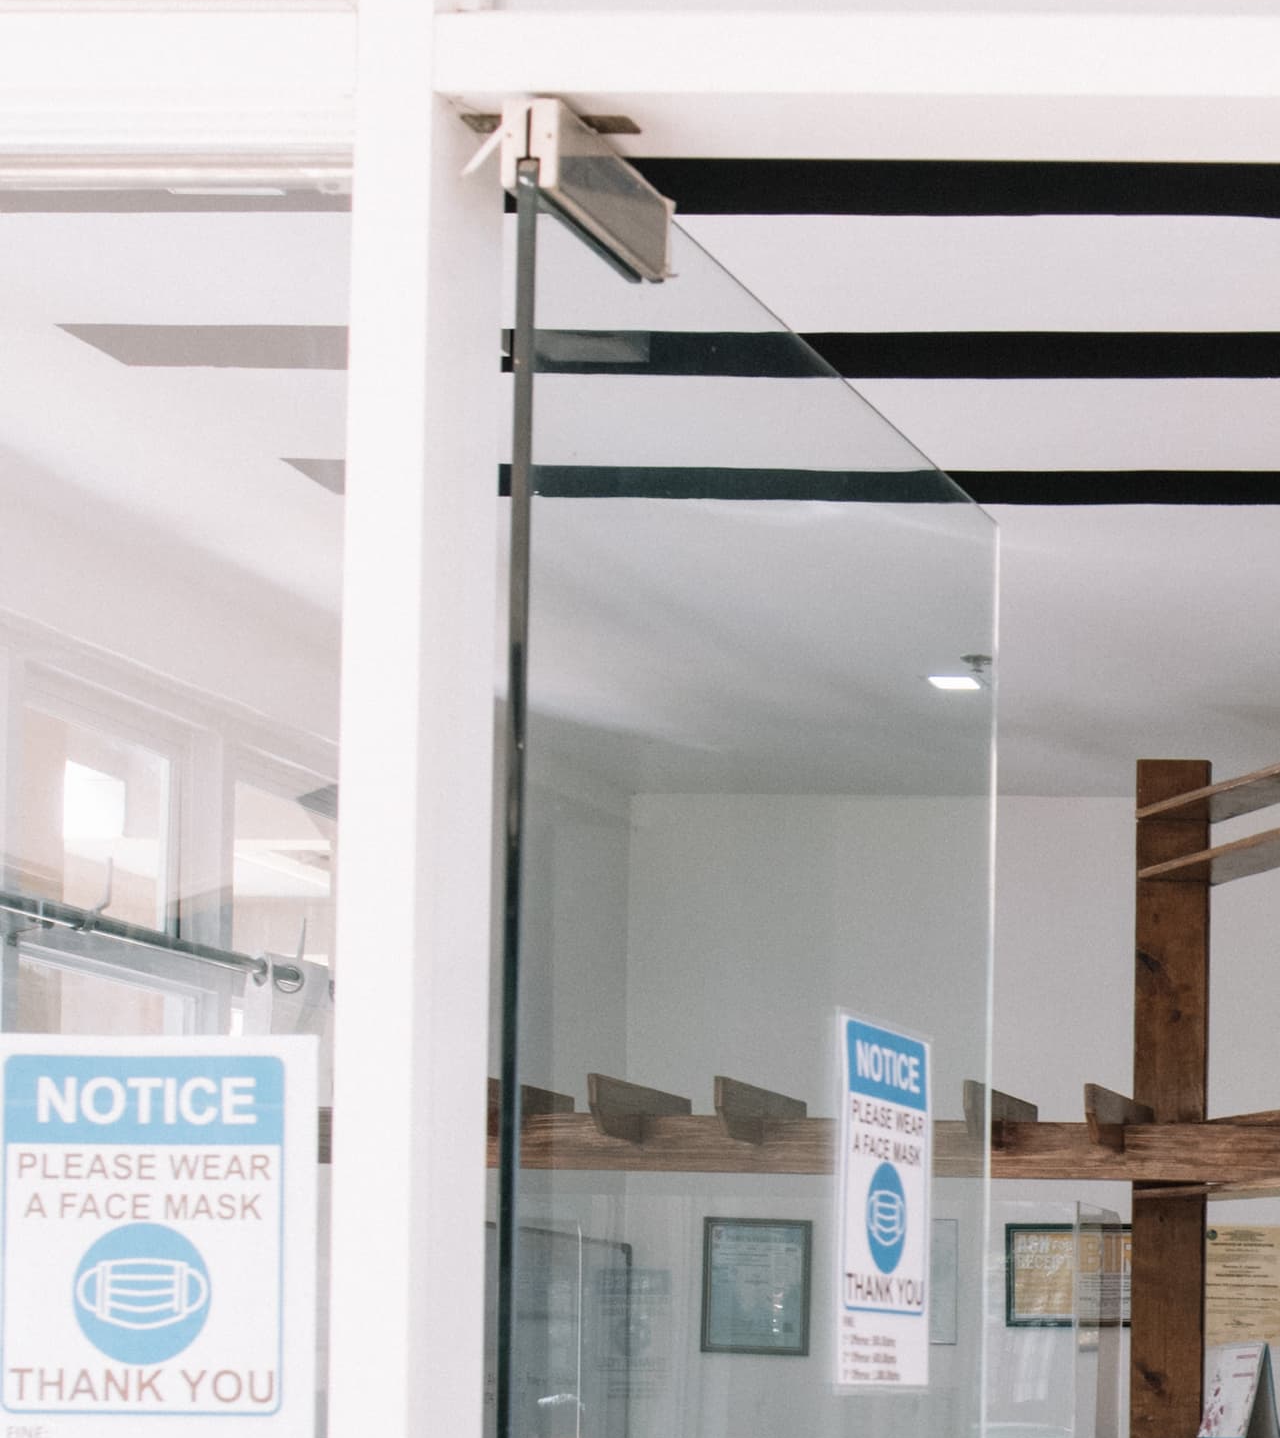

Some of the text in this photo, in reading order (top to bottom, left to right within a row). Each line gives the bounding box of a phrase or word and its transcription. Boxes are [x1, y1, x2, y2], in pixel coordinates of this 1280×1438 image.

[856, 1039, 921, 1094] NOTICE
[37, 1076, 258, 1125] NOTICE
[852, 1099, 924, 1137] PLEASE WEAR
[17, 1152, 272, 1181] PLEASE WEAR
[862, 1133, 889, 1160] FACE
[893, 1141, 922, 1167] MASK
[24, 1192, 262, 1220] A FACE MASK
[846, 1273, 924, 1306] THANK YOU
[10, 1368, 275, 1404] THANK YOU
